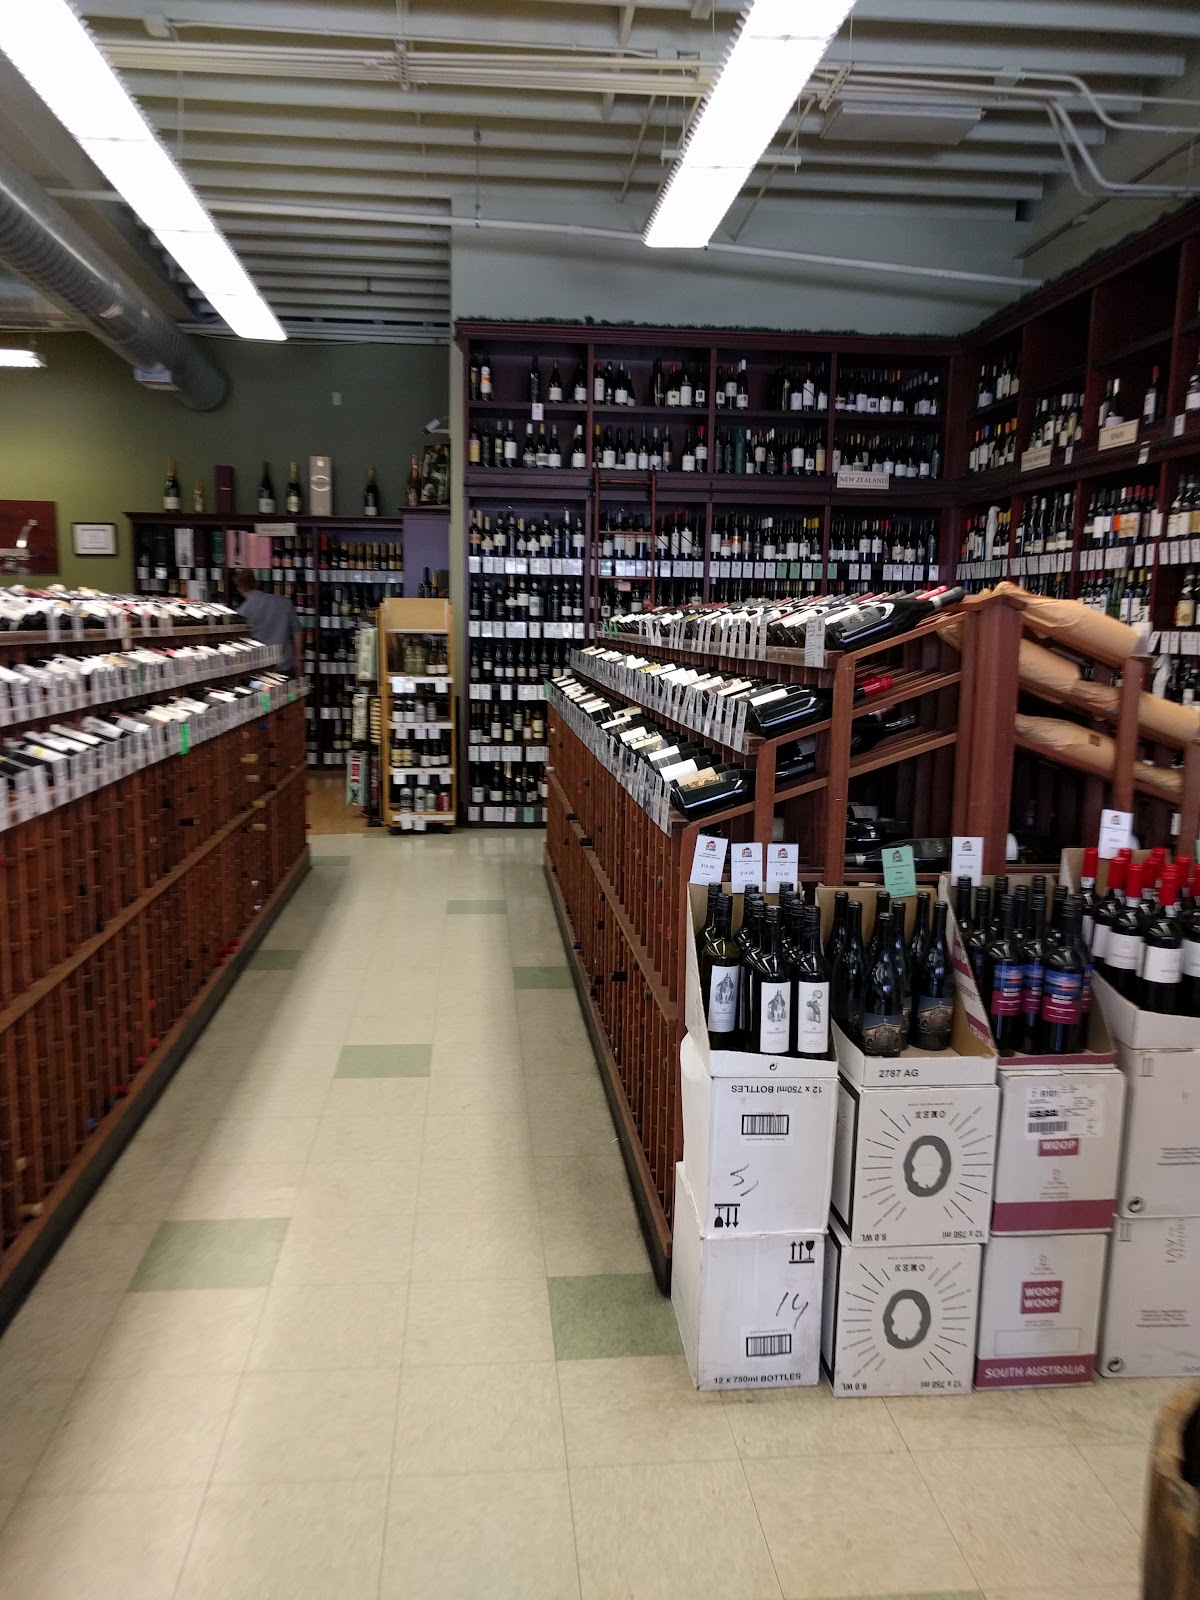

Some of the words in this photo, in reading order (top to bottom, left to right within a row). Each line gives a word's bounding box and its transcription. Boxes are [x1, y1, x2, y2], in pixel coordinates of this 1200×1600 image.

[855, 476, 887, 484] ZEALAND
[878, 1069, 901, 1078] 2787
[903, 1068, 919, 1077] AG
[731, 1085, 774, 1093] BOTTLES
[776, 1085, 803, 1093] 750ml
[1041, 1140, 1078, 1151] WOOP
[894, 1263, 927, 1272] OMEN
[1023, 1286, 1061, 1297] WOOP
[1023, 1297, 1060, 1309] WOOP
[984, 1366, 1024, 1379] SOUTH
[1025, 1364, 1087, 1377] AUSTRALIA
[733, 1375, 759, 1384] 750ml
[760, 1372, 802, 1383] BOTTLES
